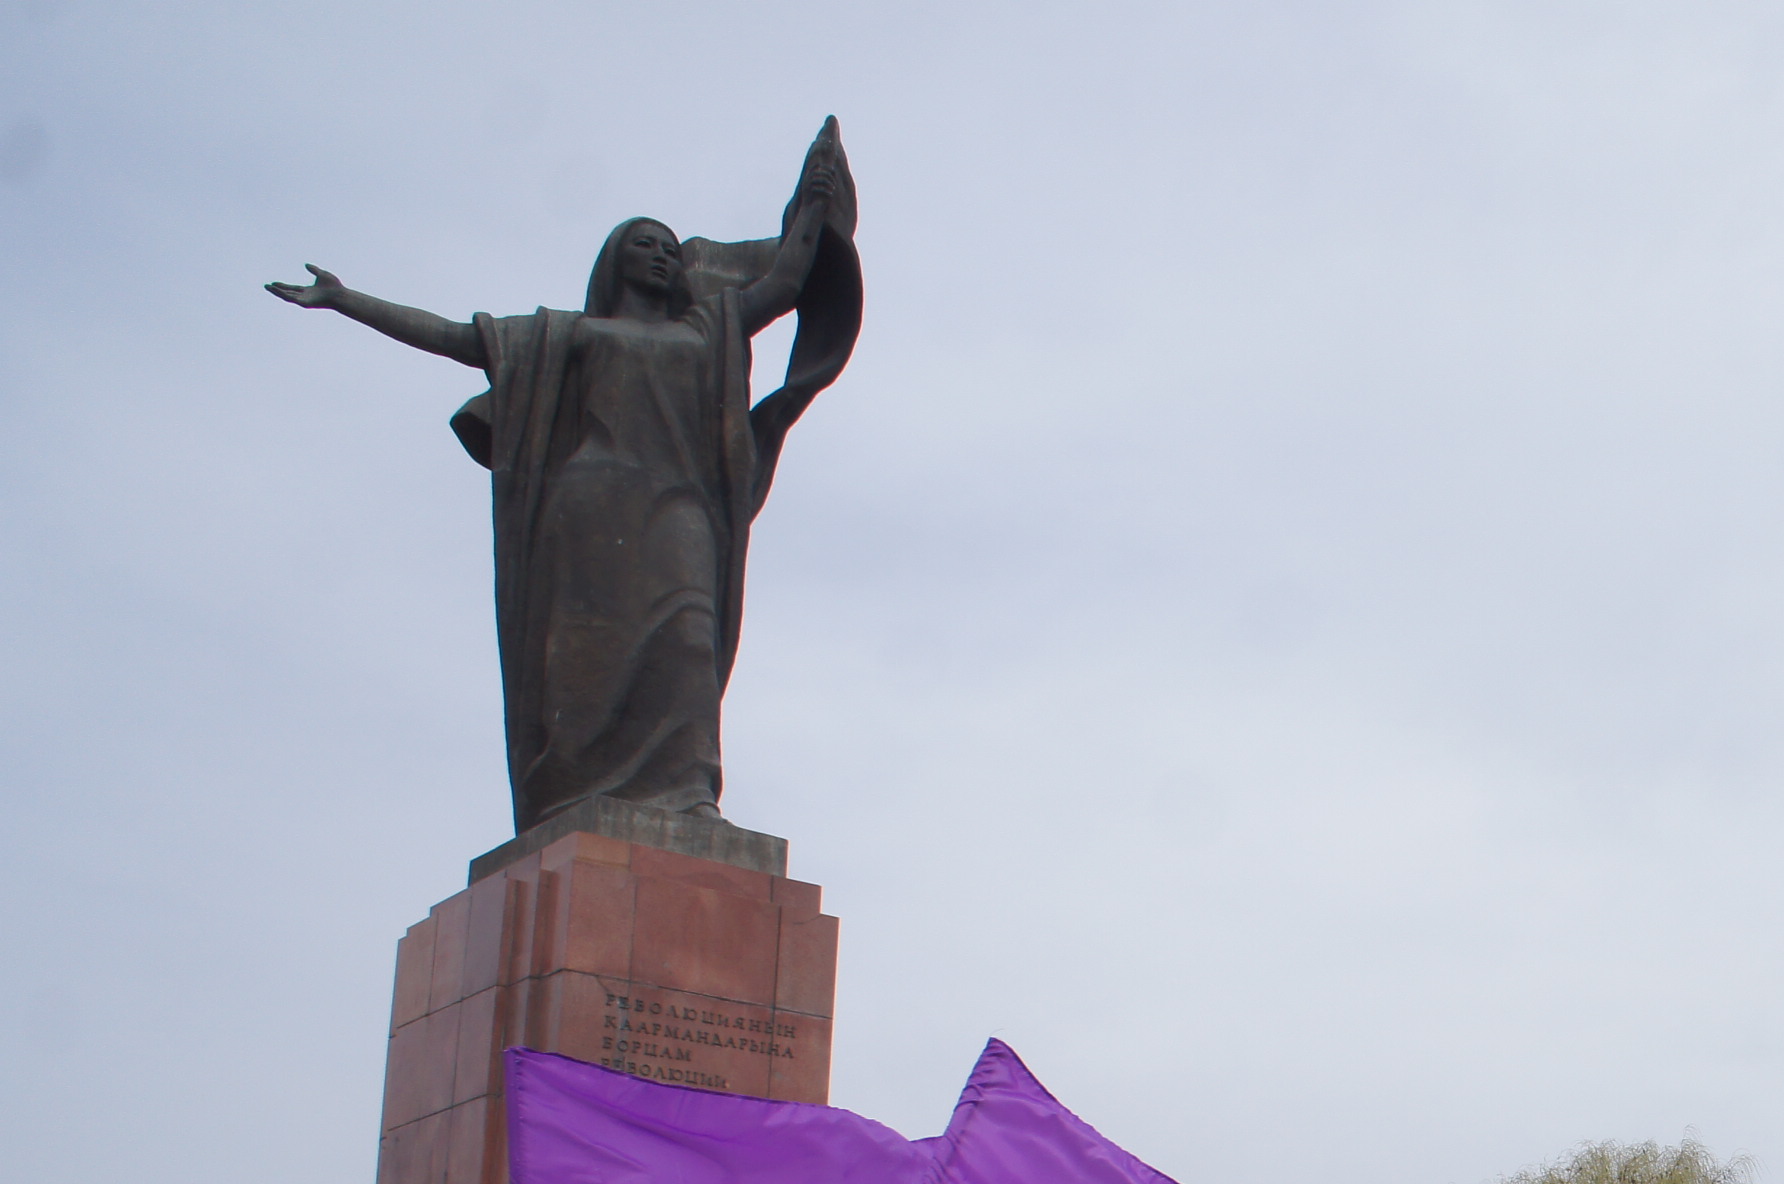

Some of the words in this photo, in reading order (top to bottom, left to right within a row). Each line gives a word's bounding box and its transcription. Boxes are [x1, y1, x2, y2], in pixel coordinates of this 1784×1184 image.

[603, 1015, 795, 1059] КААРМАНДАРЫНА
[604, 994, 797, 1039] РЕВОЛЮЦИЯНЫН
[602, 1036, 692, 1062] БОРЦАМ
